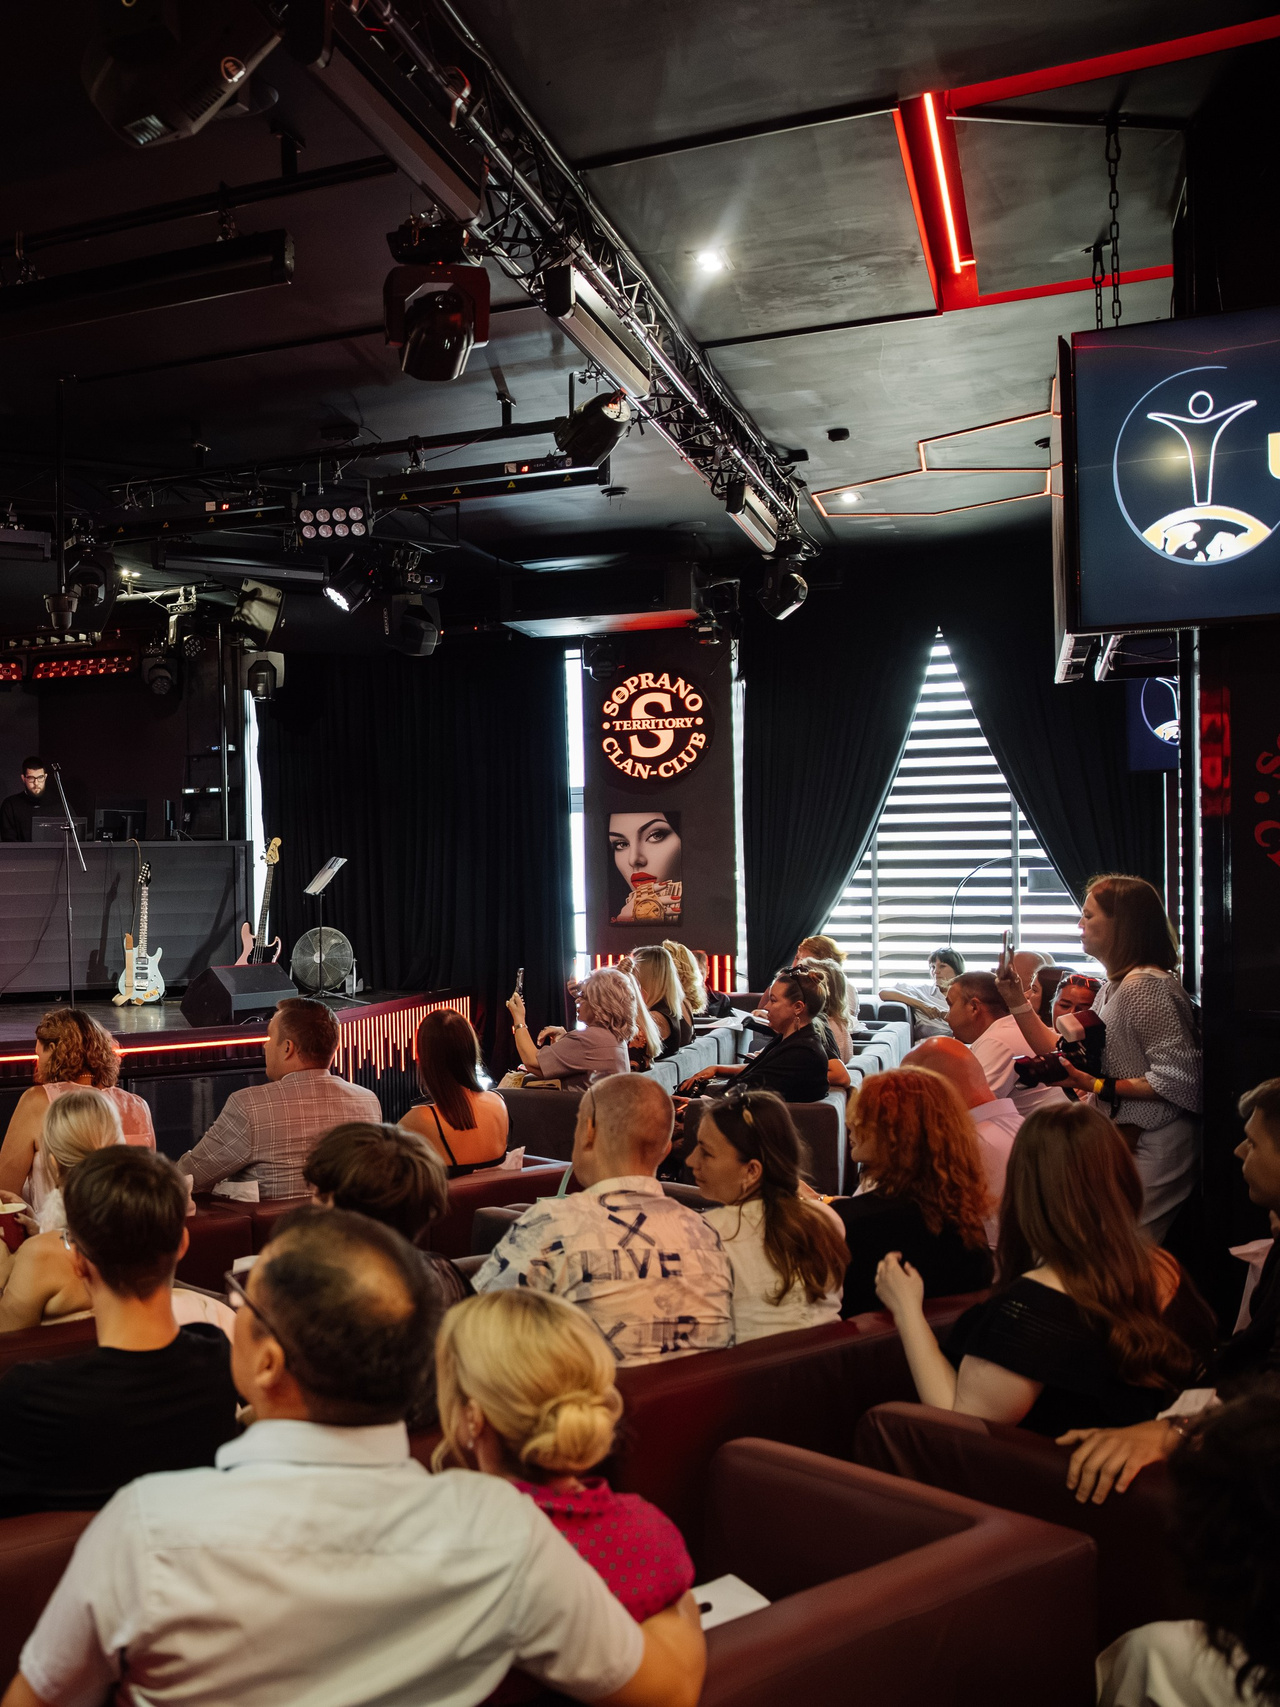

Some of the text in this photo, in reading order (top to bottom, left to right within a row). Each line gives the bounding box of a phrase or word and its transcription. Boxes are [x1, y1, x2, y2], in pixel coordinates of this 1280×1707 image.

[603, 672, 703, 717] SOPRANO
[612, 717, 695, 731] TERRITORY
[629, 692, 674, 758] S
[602, 732, 706, 779] CLAN-CLUB
